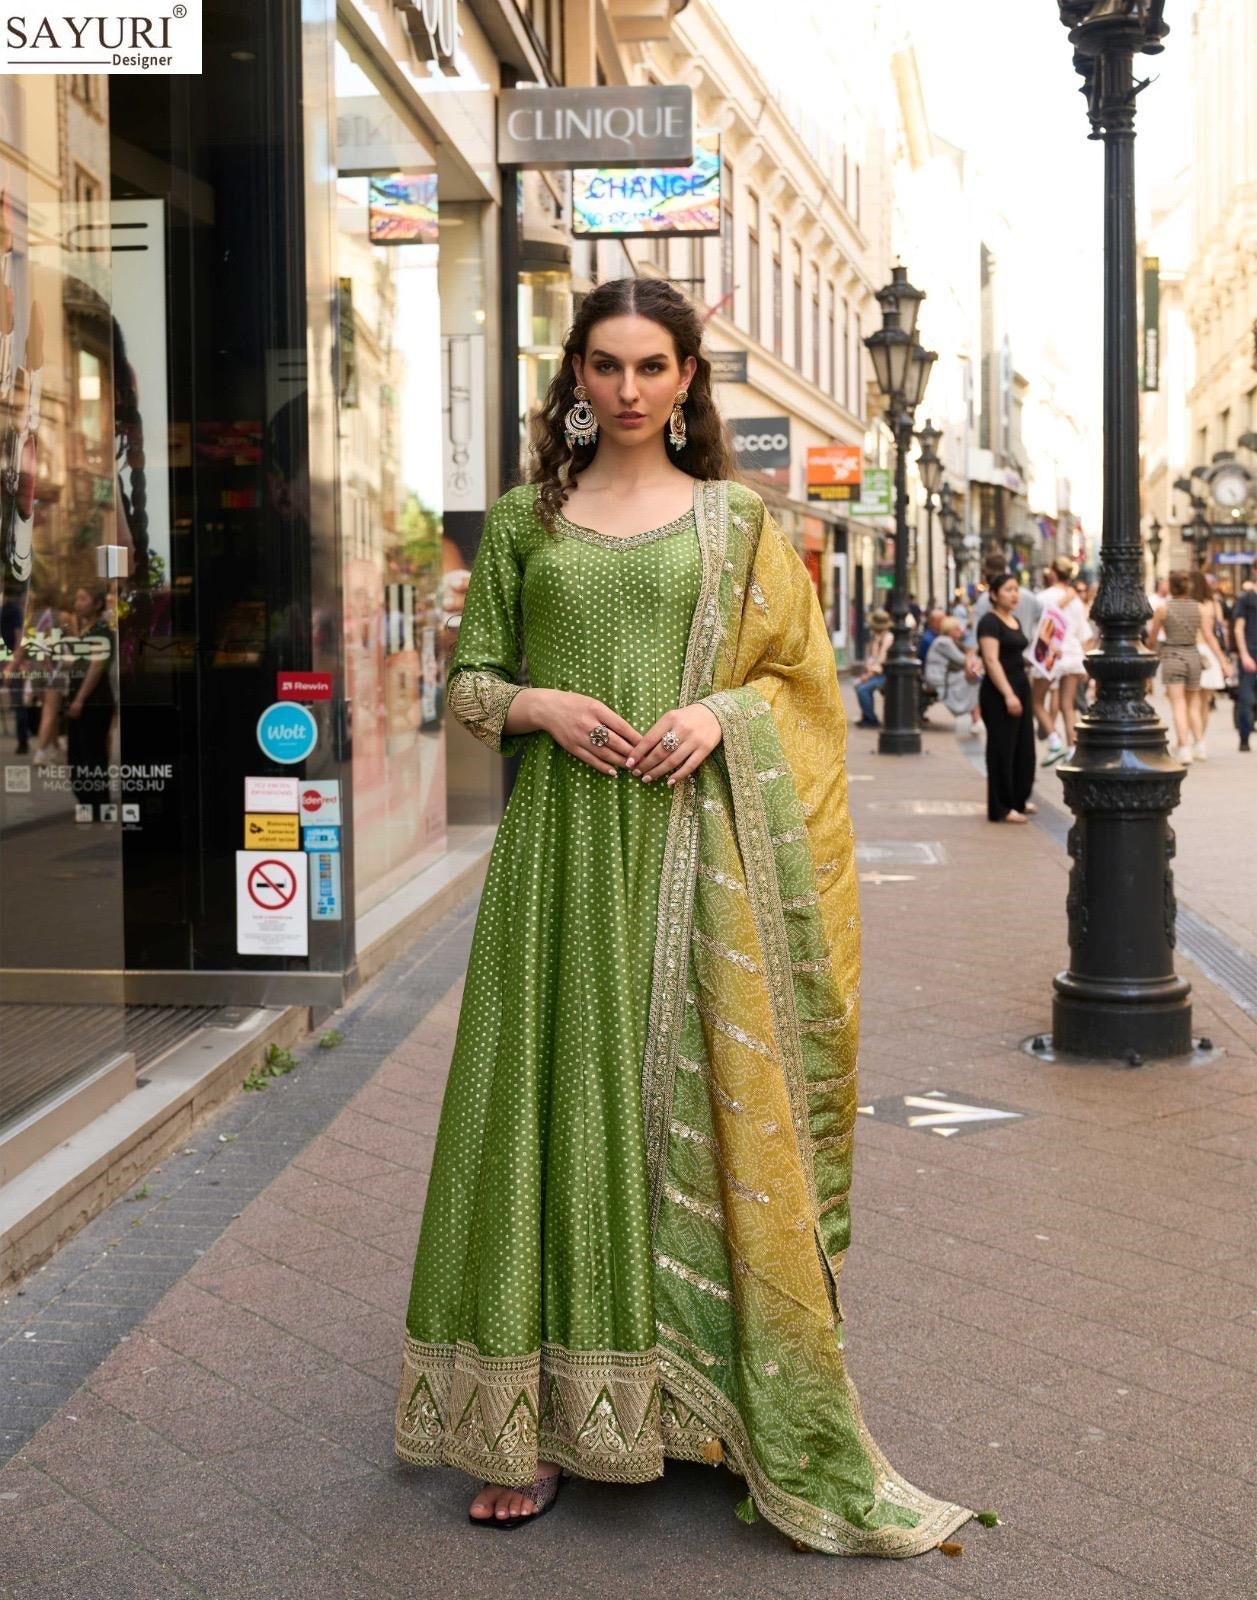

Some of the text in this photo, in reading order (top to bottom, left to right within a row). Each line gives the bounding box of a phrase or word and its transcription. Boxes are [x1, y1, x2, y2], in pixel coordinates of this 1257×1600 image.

[507, 106, 684, 143] CLINIQUE
[584, 175, 706, 200] CHANGE
[732, 433, 789, 452] ecco
[294, 681, 329, 691] Rewin
[267, 724, 306, 739] Wolt
[37, 765, 75, 778] MEET
